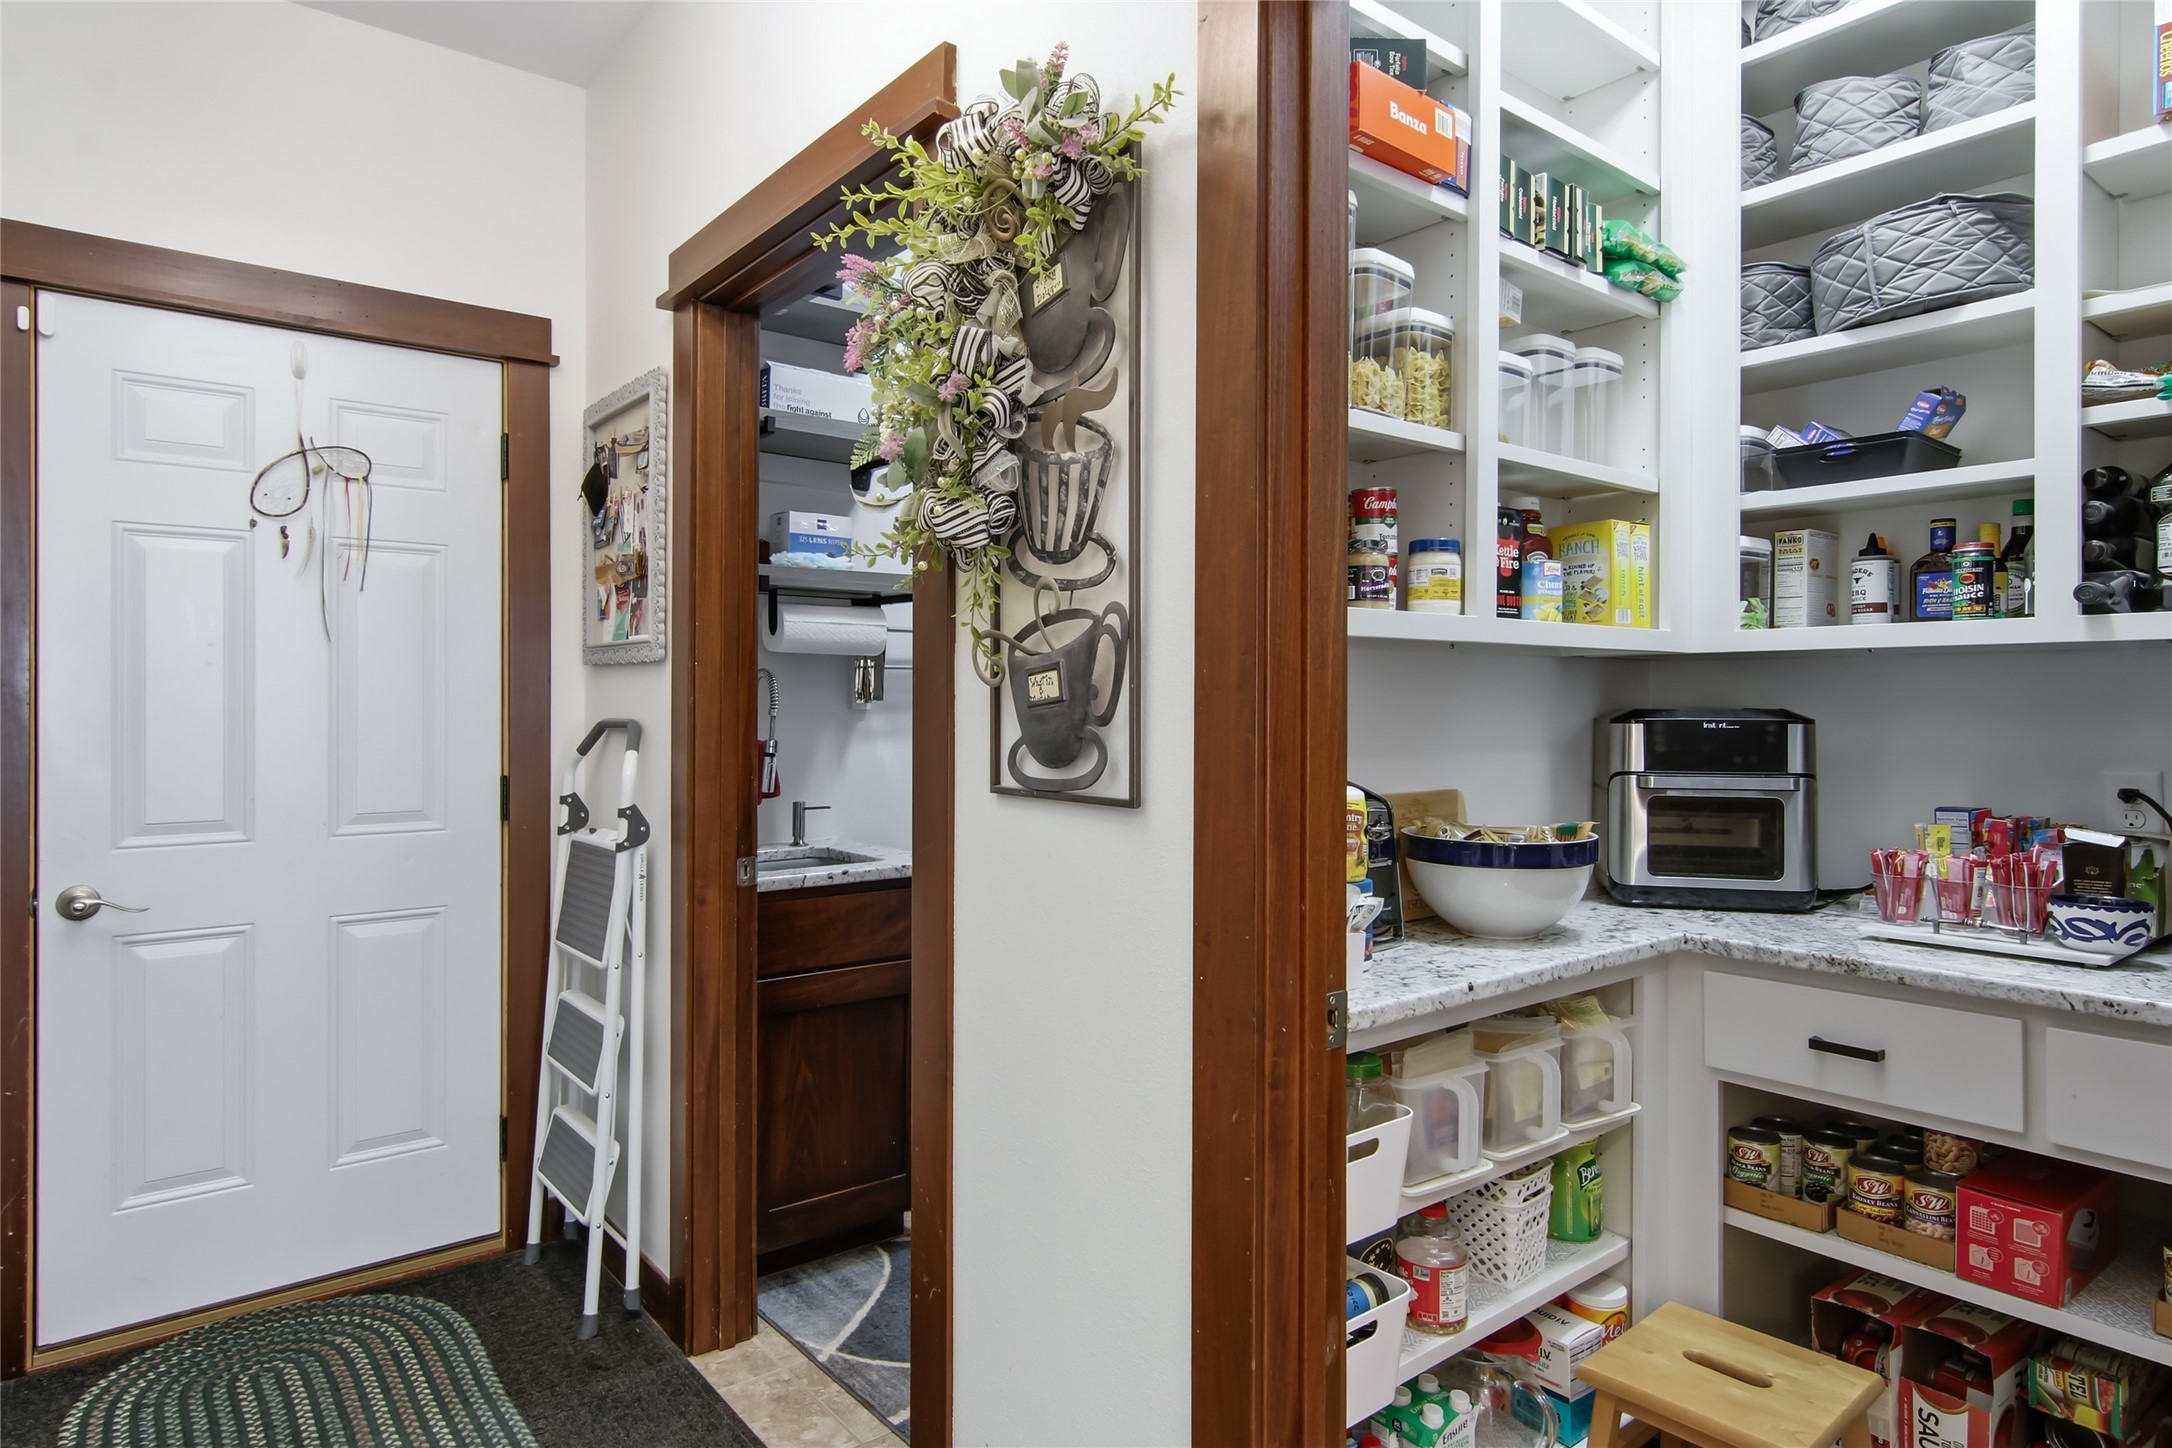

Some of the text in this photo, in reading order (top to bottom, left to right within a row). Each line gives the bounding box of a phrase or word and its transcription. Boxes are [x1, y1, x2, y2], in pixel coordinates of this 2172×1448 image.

[1389, 100, 1428, 136] Banza
[773, 383, 802, 395] Thanks
[773, 393, 811, 406] for joining
[786, 404, 804, 413] fight
[805, 407, 832, 419] against
[808, 536, 827, 545] LENS
[1778, 536, 1802, 546] PANKO
[1558, 539, 1600, 558] RANCH
[1500, 557, 1520, 569] Fire
[1747, 1164, 1767, 1172] BEANS
[1442, 1419, 1469, 1445] Ensure
[1918, 1406, 1941, 1448] SAU
